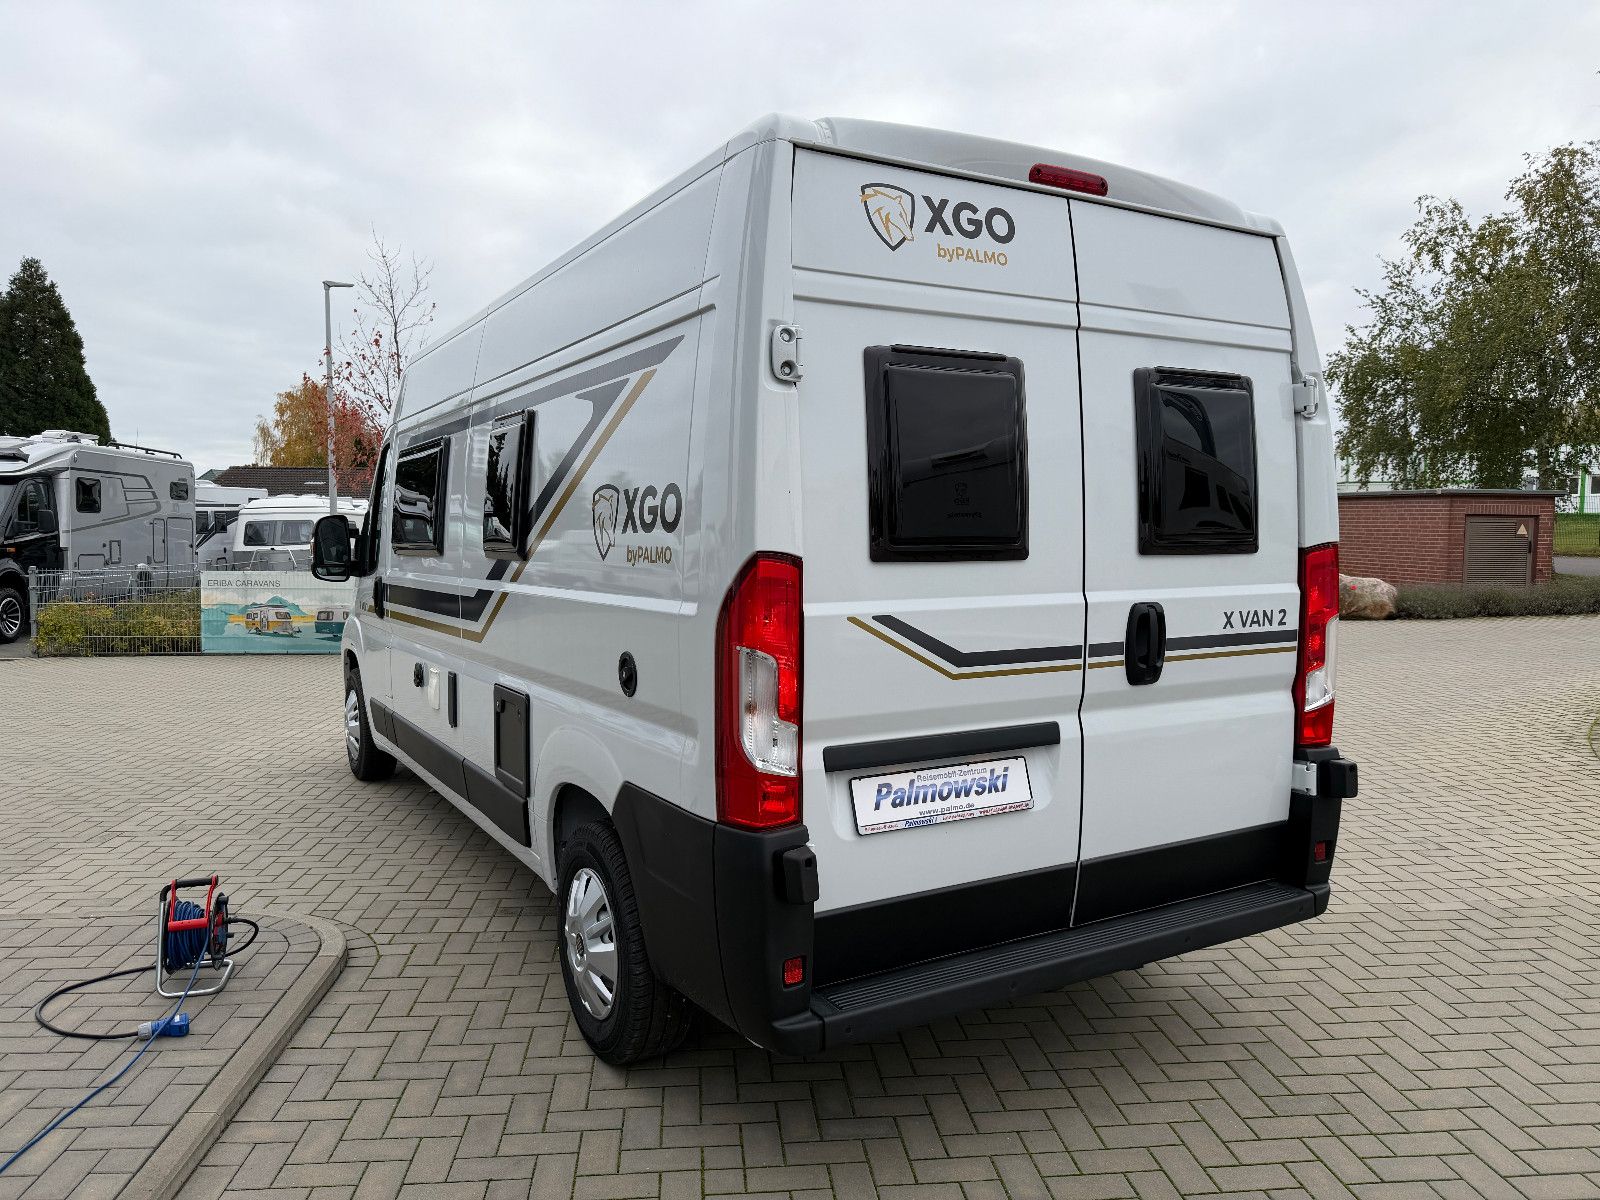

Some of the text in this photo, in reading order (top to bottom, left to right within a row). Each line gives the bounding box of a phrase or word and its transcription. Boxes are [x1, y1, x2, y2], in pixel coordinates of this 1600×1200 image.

[921, 195, 1016, 244] XGO
[937, 243, 1008, 266] byPALMO
[621, 483, 682, 534] XGO
[626, 545, 672, 567] byPALMO
[1223, 608, 1287, 629] X VAN 2
[874, 766, 1009, 811] Palmowski
[919, 802, 975, 816] www.palmo.de
